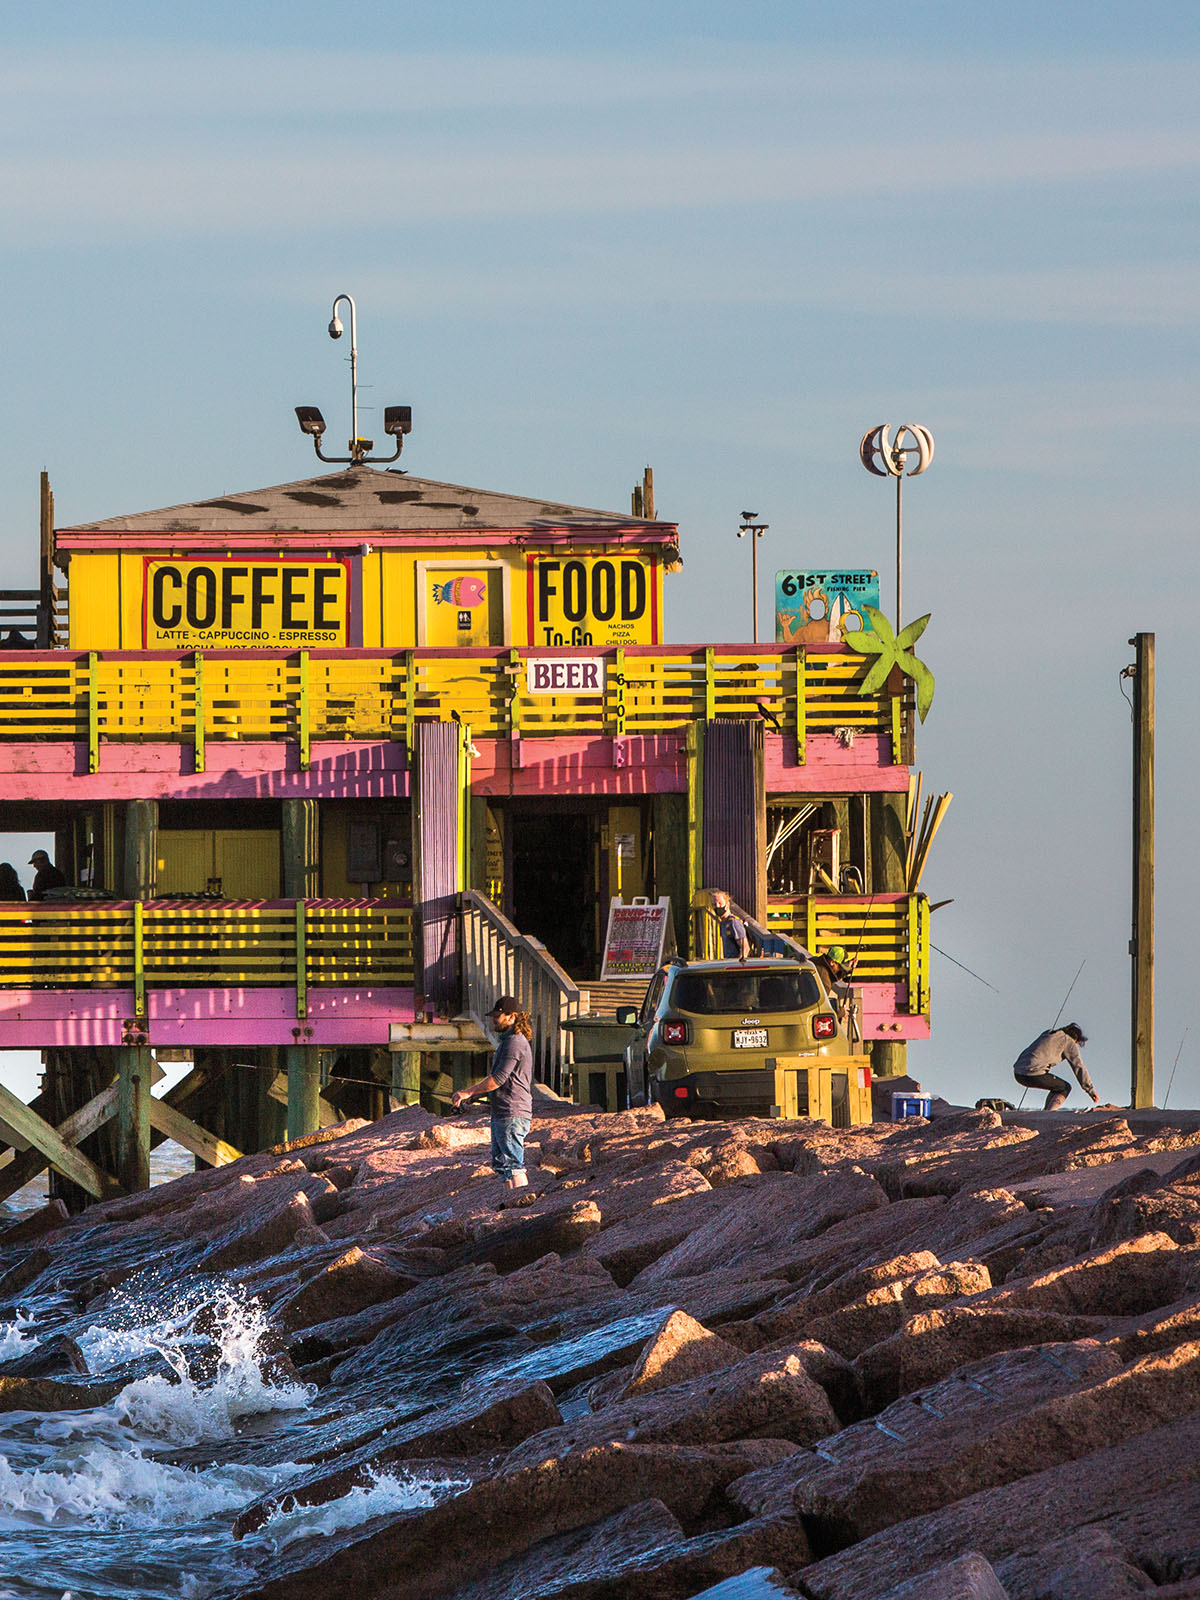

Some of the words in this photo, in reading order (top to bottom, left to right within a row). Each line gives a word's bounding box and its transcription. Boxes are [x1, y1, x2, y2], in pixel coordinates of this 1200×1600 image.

[152, 566, 341, 630] COFFEE
[538, 560, 646, 622] FOOD
[781, 574, 827, 596] 61ST
[830, 574, 873, 585] STREET
[156, 630, 190, 640] LATTE
[198, 631, 270, 640] CAPPUCCINO
[278, 631, 338, 641] ESPRESSO
[543, 626, 593, 646] To-Go
[533, 663, 599, 689] BEER
[616, 673, 625, 733] 6101
